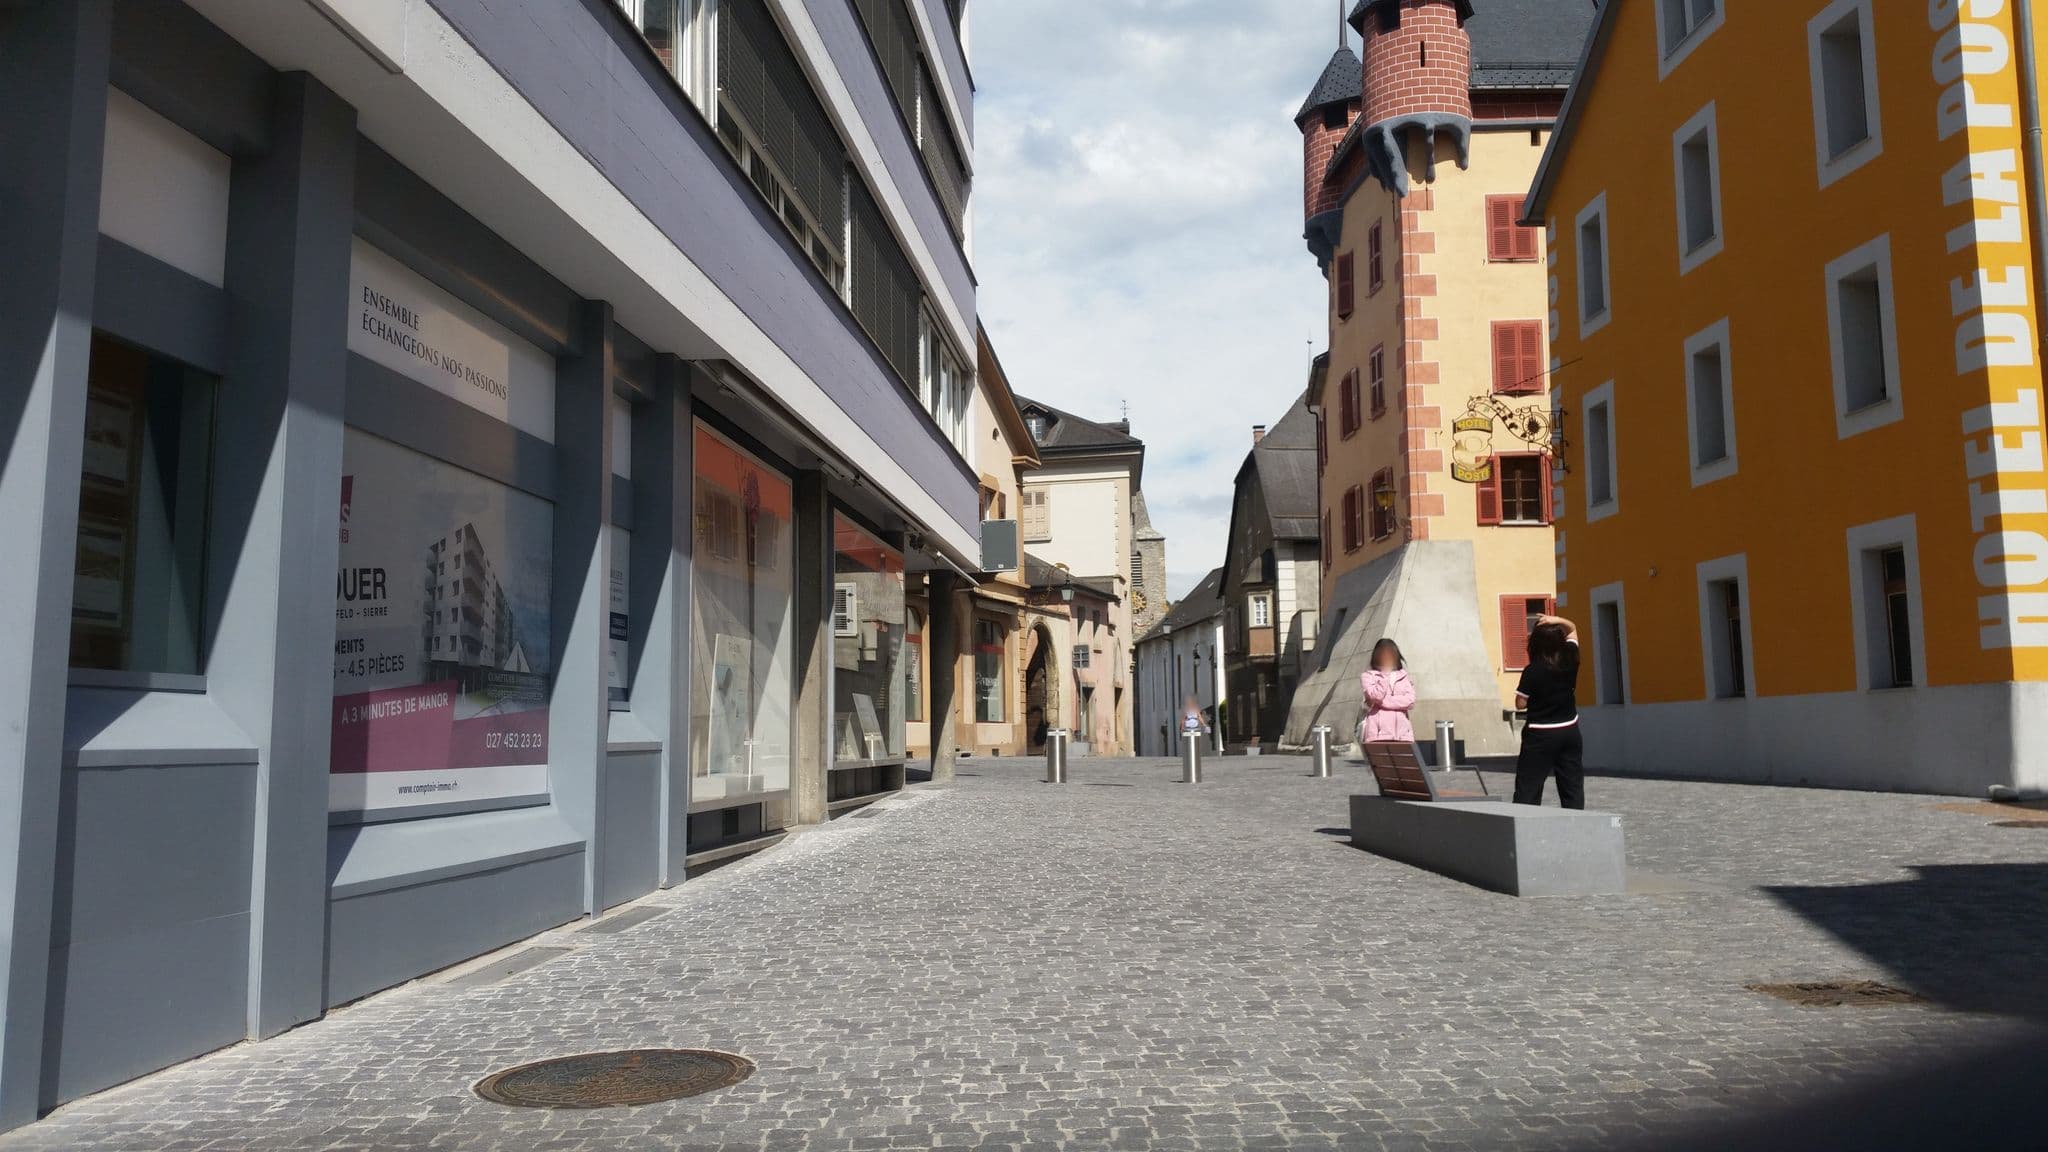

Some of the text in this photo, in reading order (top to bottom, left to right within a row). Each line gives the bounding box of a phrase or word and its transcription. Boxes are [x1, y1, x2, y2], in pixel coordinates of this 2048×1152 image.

[1941, 148, 2023, 255] LA
[363, 286, 420, 331] ENSEMBLE
[1951, 265, 2034, 377] DE
[362, 309, 507, 400] ÉCHANGEONS NOS PASSIONS
[1961, 388, 2048, 649] HOTEL
[337, 568, 387, 602] UER
[363, 607, 388, 617] SIERRE
[368, 653, 405, 675] PIÈCES
[342, 692, 449, 724] A 3 MINUTES DE MANOR
[486, 733, 542, 749] 027 452 23 23
